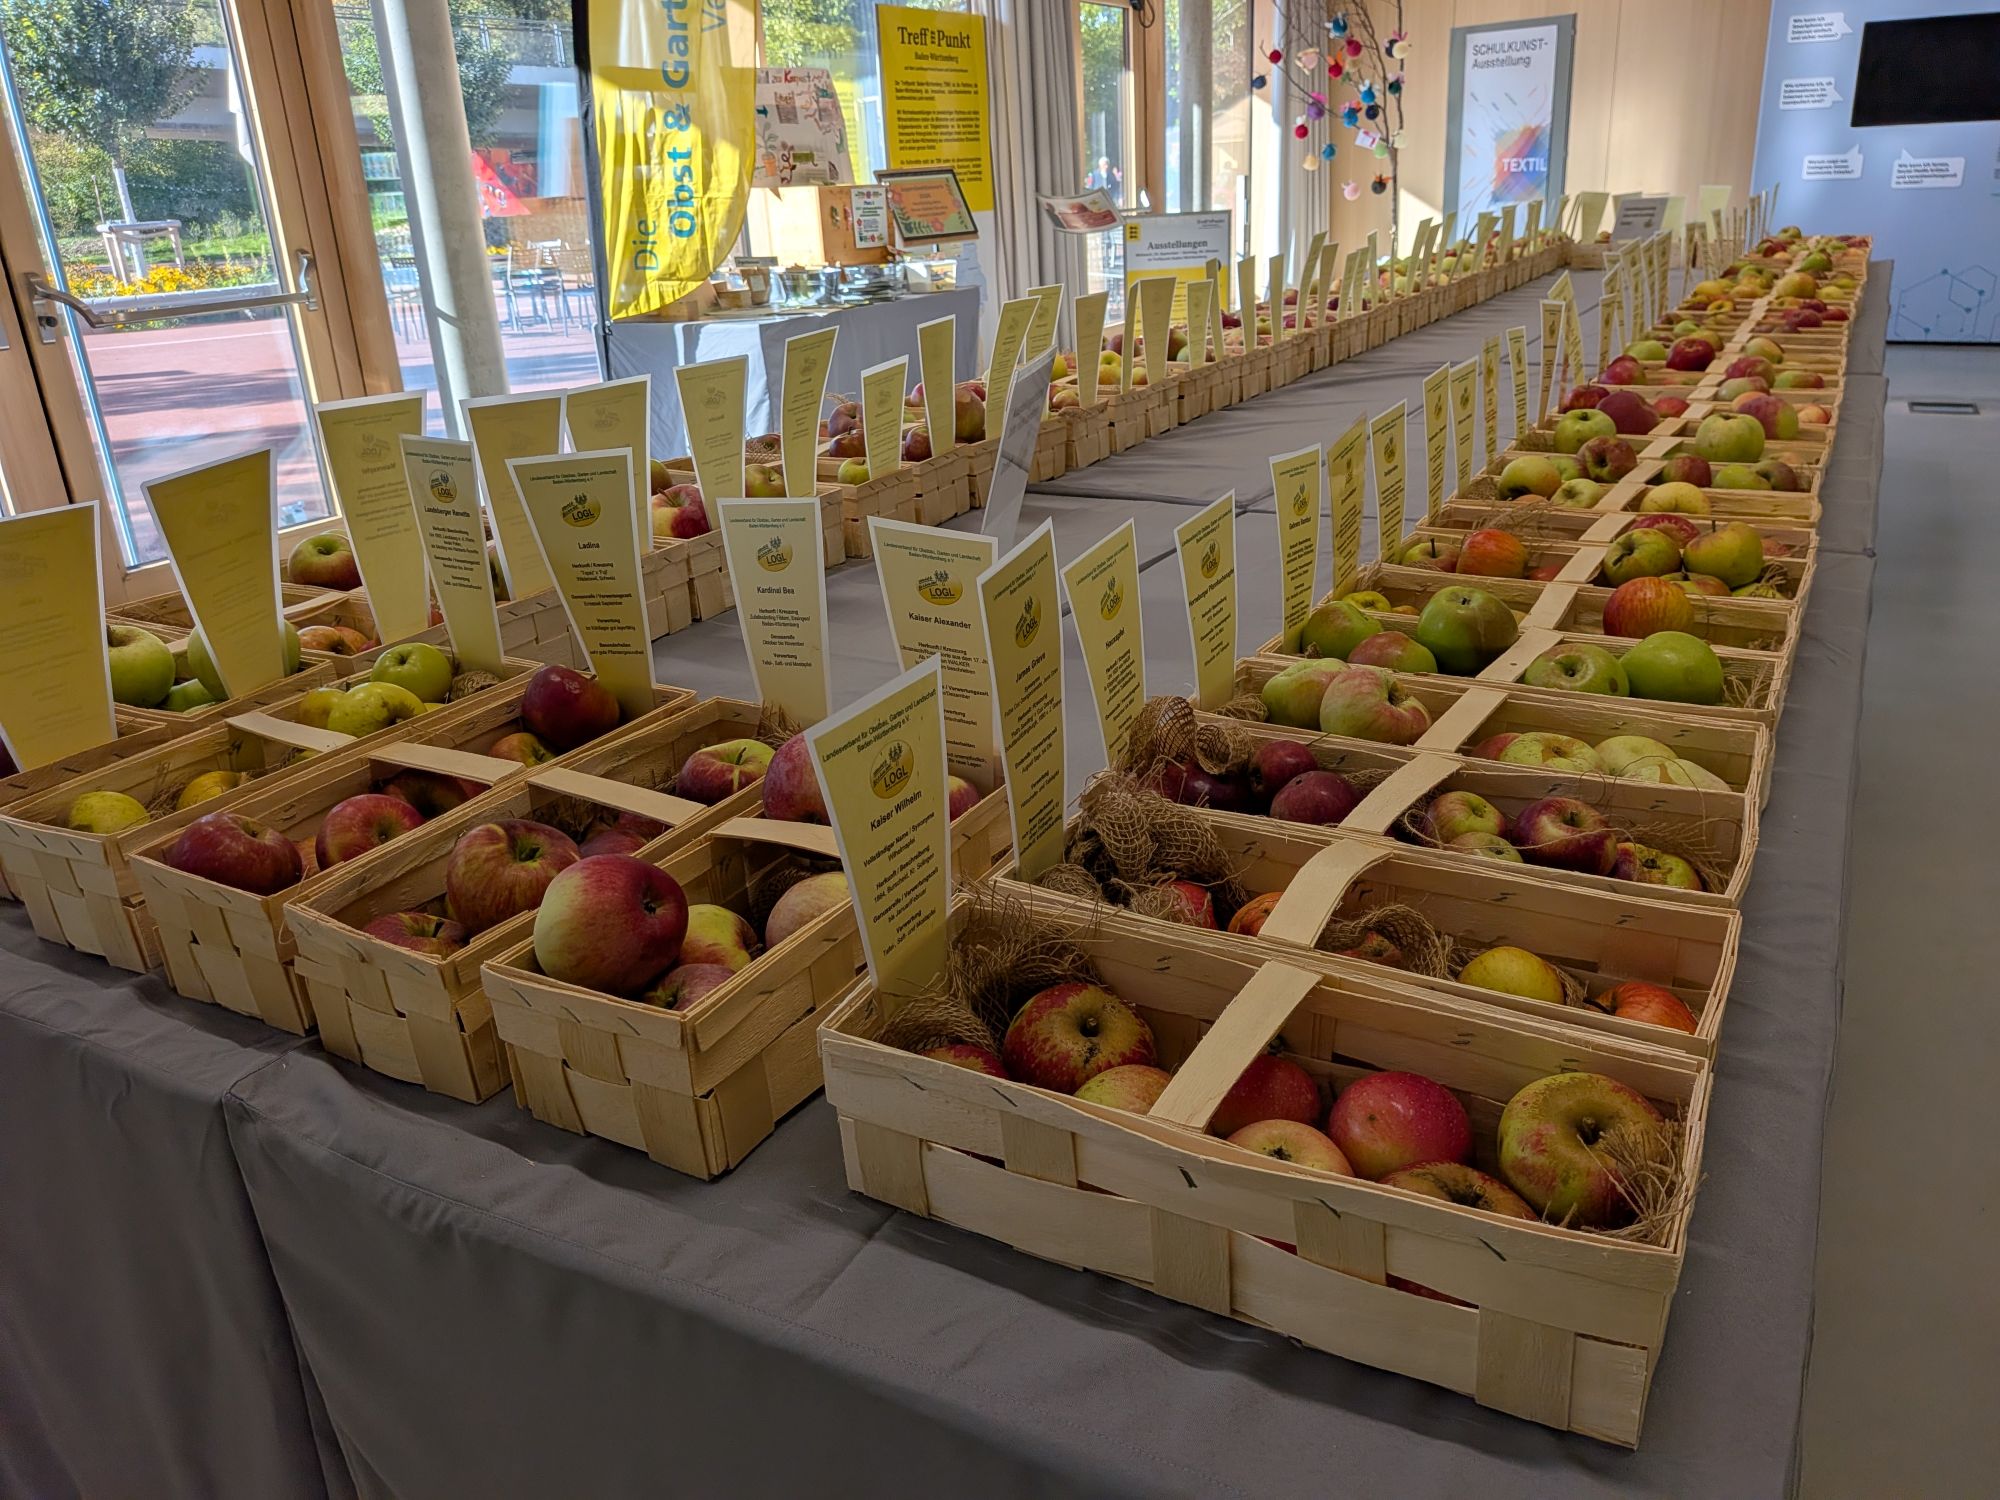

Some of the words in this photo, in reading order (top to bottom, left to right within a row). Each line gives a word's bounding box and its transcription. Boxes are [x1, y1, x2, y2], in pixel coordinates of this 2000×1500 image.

[897, 27, 929, 46] Treff
[937, 30, 971, 48] Punkt
[1472, 38, 1548, 56] SCHULKUNST-
[1472, 55, 1531, 69] Ausstellung
[664, 103, 692, 132] &
[1503, 157, 1547, 172] TEXTIL
[667, 146, 697, 238] Obst
[633, 219, 659, 271] Die
[1147, 240, 1208, 250] Ausstellungen
[438, 488, 453, 496] LOGL
[424, 506, 451, 517] Landsberger
[572, 509, 594, 520] LOGL
[766, 555, 786, 565] LOGL
[929, 588, 955, 597] LOGL
[908, 611, 932, 623] Kaiser
[934, 617, 971, 629] Alexander
[1022, 619, 1038, 638] LOGL
[1015, 664, 1031, 684] James
[1031, 652, 1046, 670] Grieve
[884, 765, 908, 789] LOGL
[871, 810, 893, 831] Kaiser
[895, 790, 922, 814] Wilhelm
